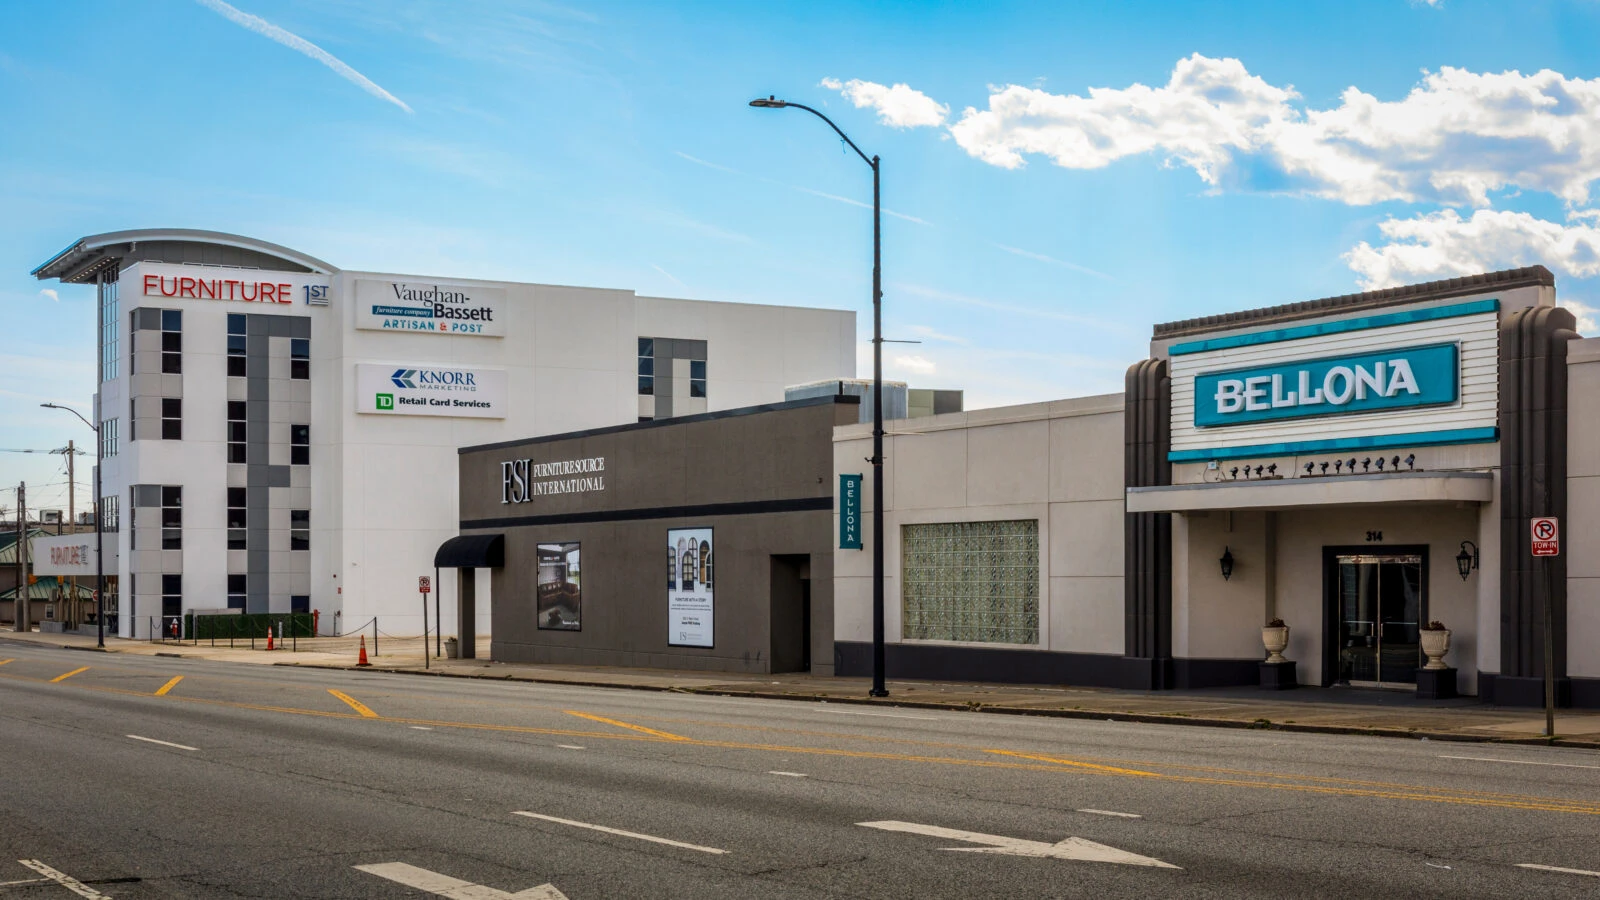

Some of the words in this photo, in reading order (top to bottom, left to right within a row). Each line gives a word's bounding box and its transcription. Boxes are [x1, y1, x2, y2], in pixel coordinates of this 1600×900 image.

[144, 275, 292, 304] FURNITURE
[303, 285, 329, 305] 1ST
[392, 283, 471, 307] Vaughan-
[404, 309, 431, 317] company
[434, 303, 493, 321] Bassett
[440, 322, 447, 331] &
[452, 323, 482, 333] POST
[420, 370, 476, 385] KNORR
[1214, 359, 1420, 413] BELLONA
[378, 396, 392, 407] TD
[399, 397, 426, 405] Retail
[429, 399, 450, 407] Card
[453, 400, 491, 408] Services
[501, 459, 531, 504] FSI
[533, 477, 604, 495] INTERNATIONAL
[1366, 531, 1383, 542] 314
